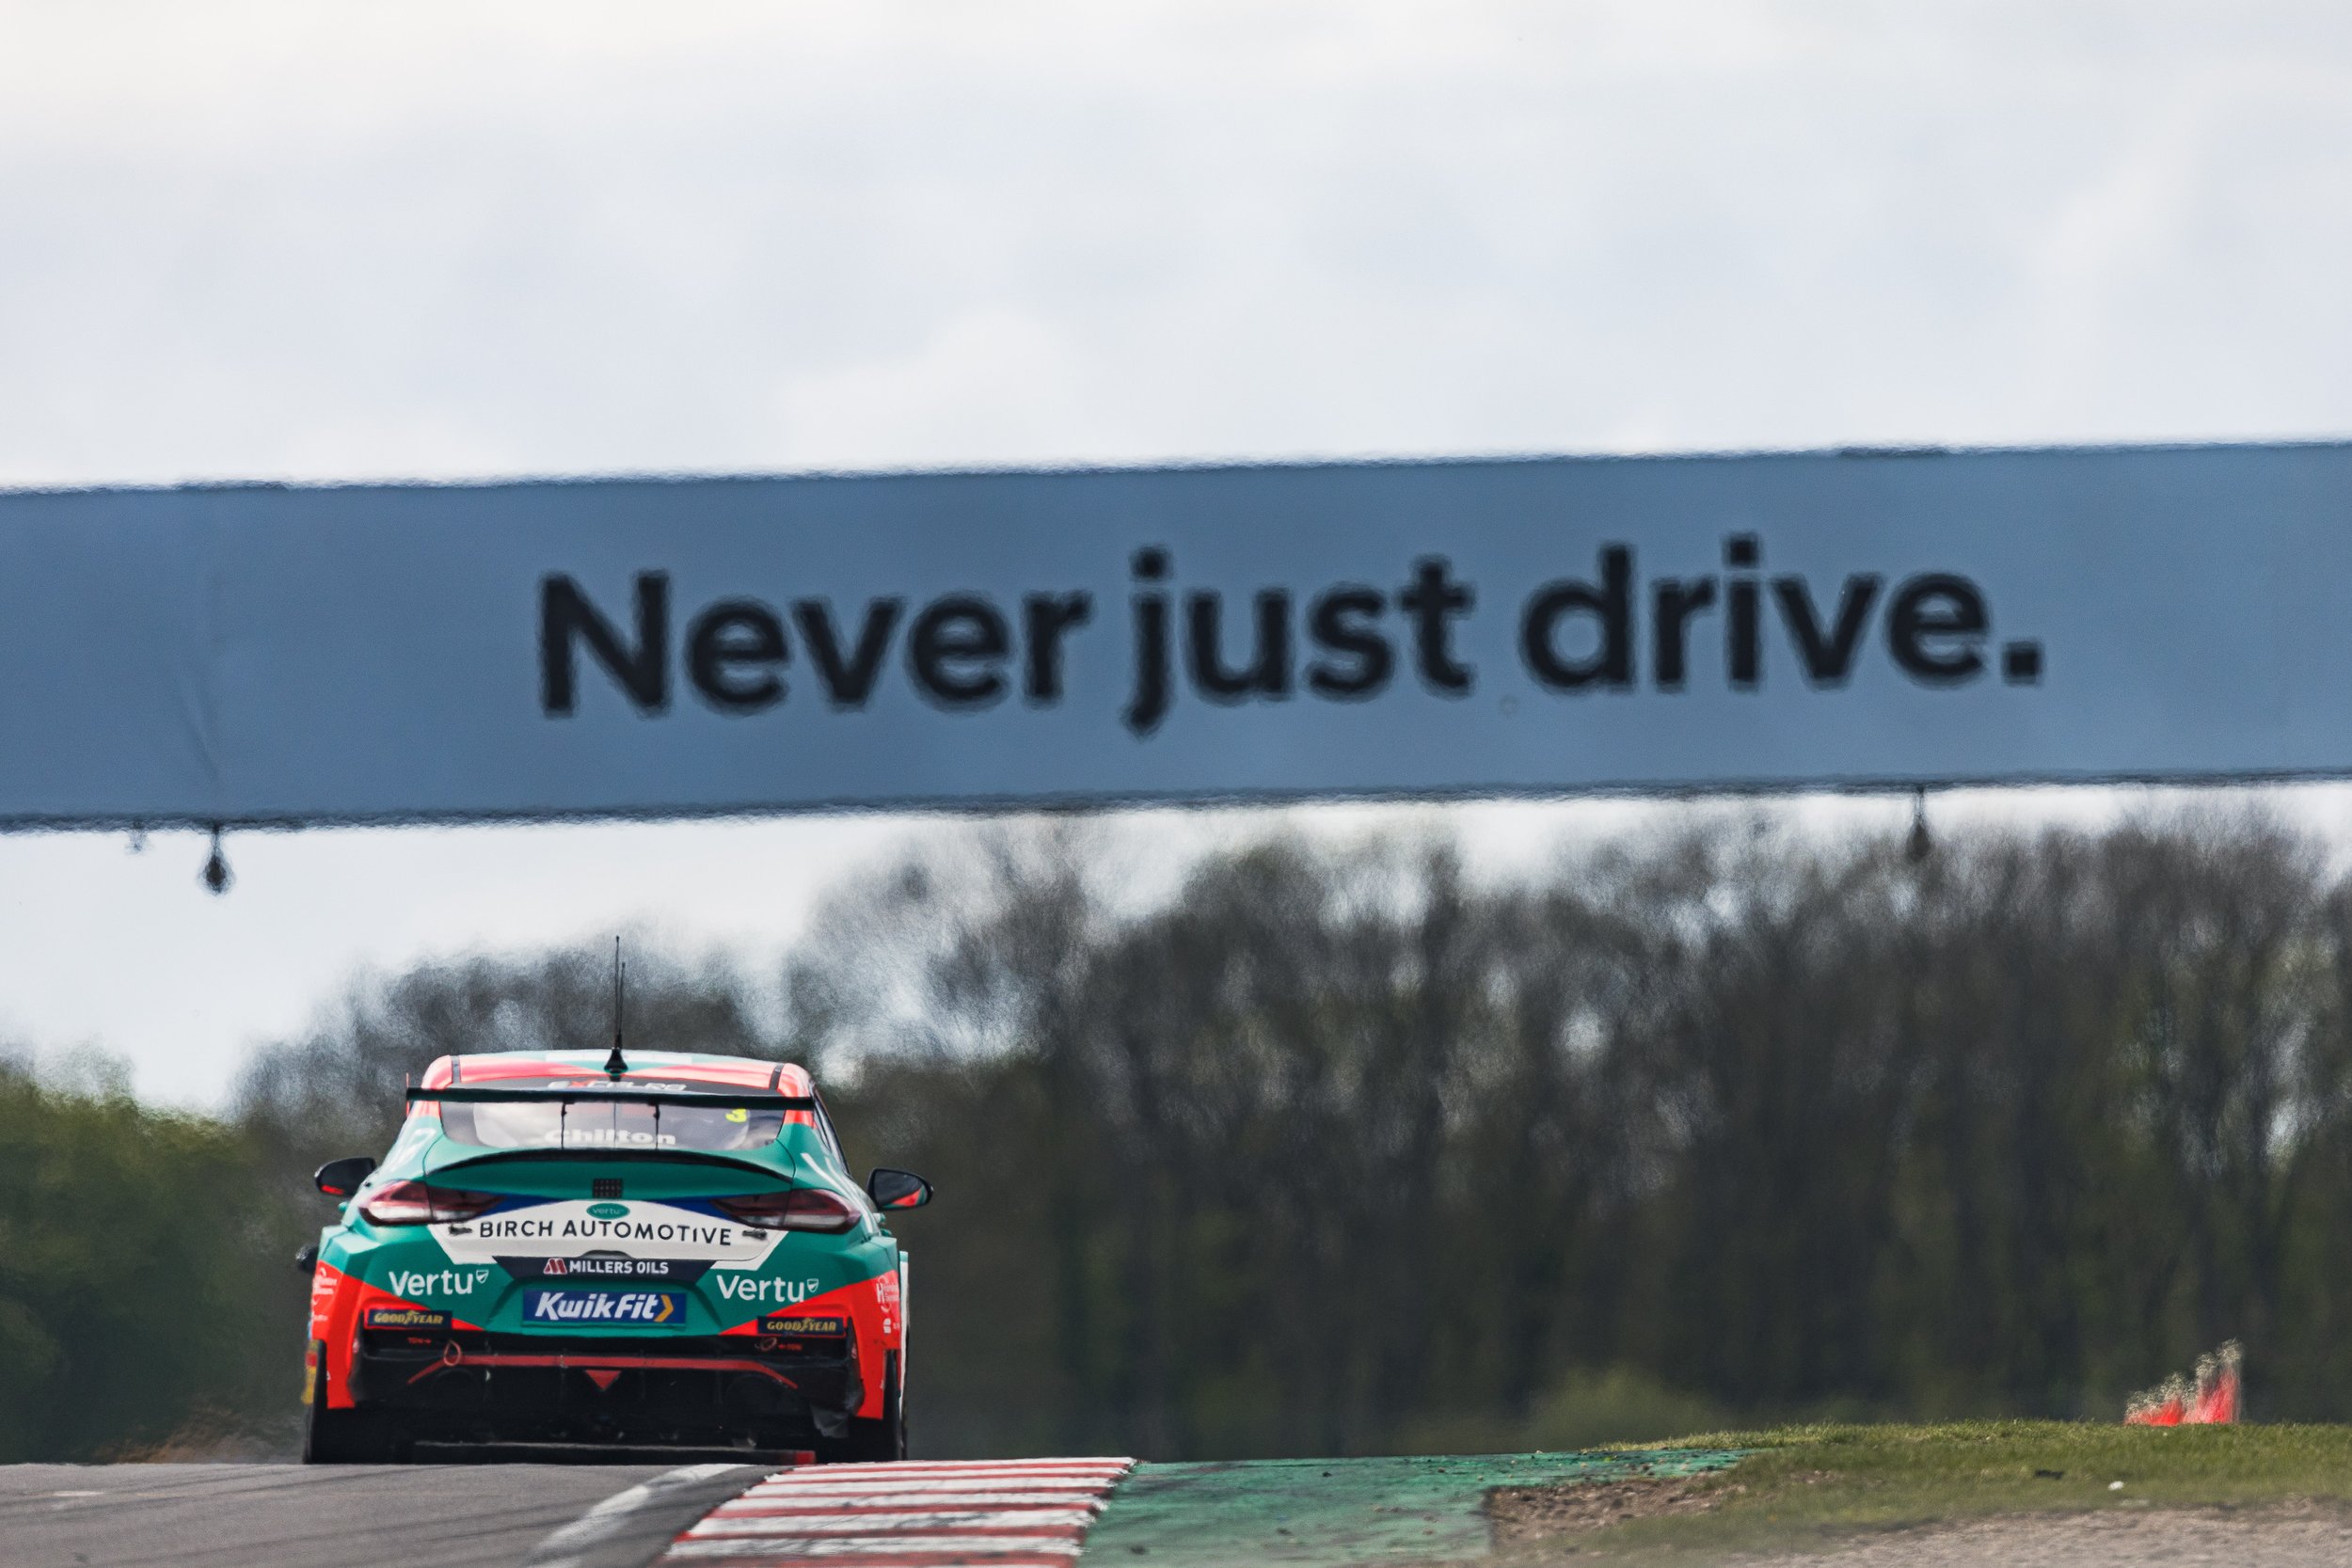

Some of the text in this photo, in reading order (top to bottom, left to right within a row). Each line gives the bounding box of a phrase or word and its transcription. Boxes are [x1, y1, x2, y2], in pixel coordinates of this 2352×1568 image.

[540, 532, 2042, 738] Never just drive.
[479, 1220, 732, 1246] BIRCH AUTOMOTIVE
[568, 1259, 670, 1275] MILLERS OILS
[388, 1270, 473, 1297] Vertu
[716, 1275, 805, 1303] Vertu
[373, 1311, 444, 1325] GOODYEAR
[767, 1319, 836, 1332] GOODYEAR
